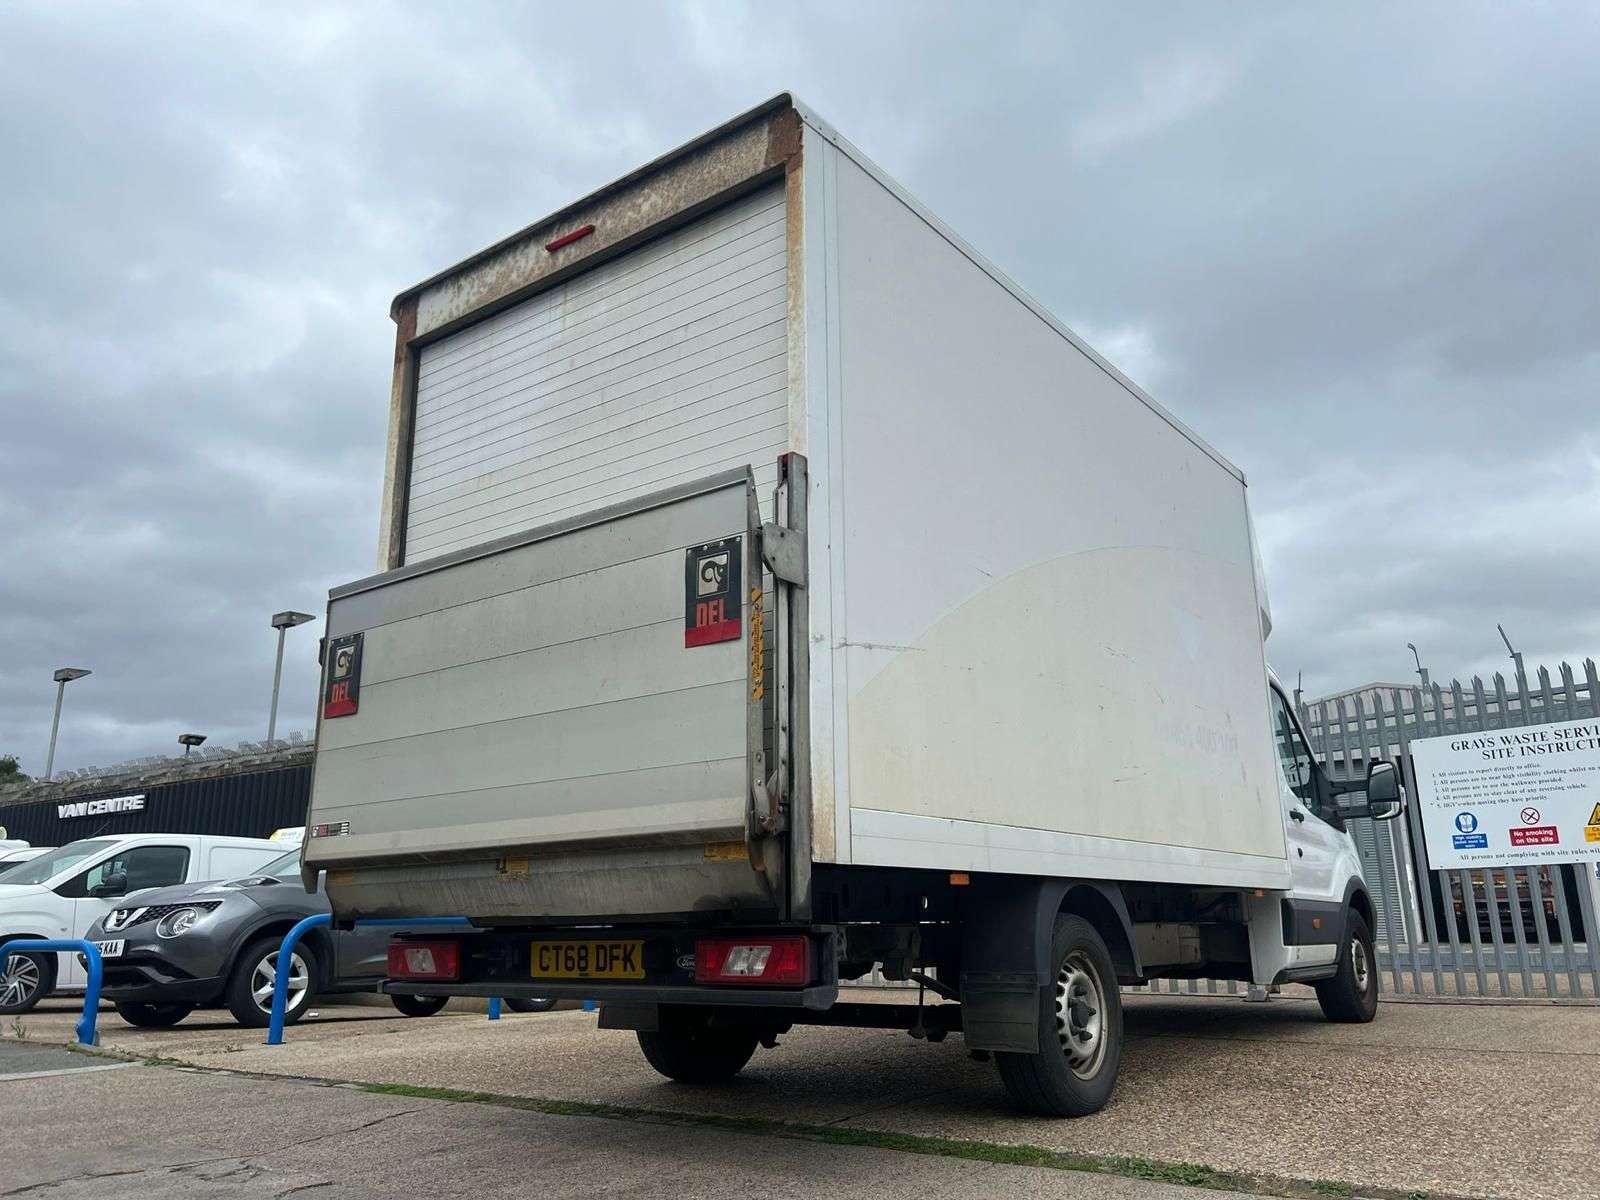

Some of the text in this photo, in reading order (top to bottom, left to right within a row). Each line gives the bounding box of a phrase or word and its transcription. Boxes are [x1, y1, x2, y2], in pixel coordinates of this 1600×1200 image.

[696, 599, 728, 628] DEL
[331, 681, 351, 703] DEL
[1451, 737, 1495, 751] GRAYS
[1499, 731, 1549, 746] WASTE
[1482, 747, 1515, 760] SITE
[58, 795, 145, 818] VAN CENTRE
[1525, 829, 1554, 837] smoking
[1507, 851, 1539, 859] complying
[540, 943, 636, 972] CT68 DFK
